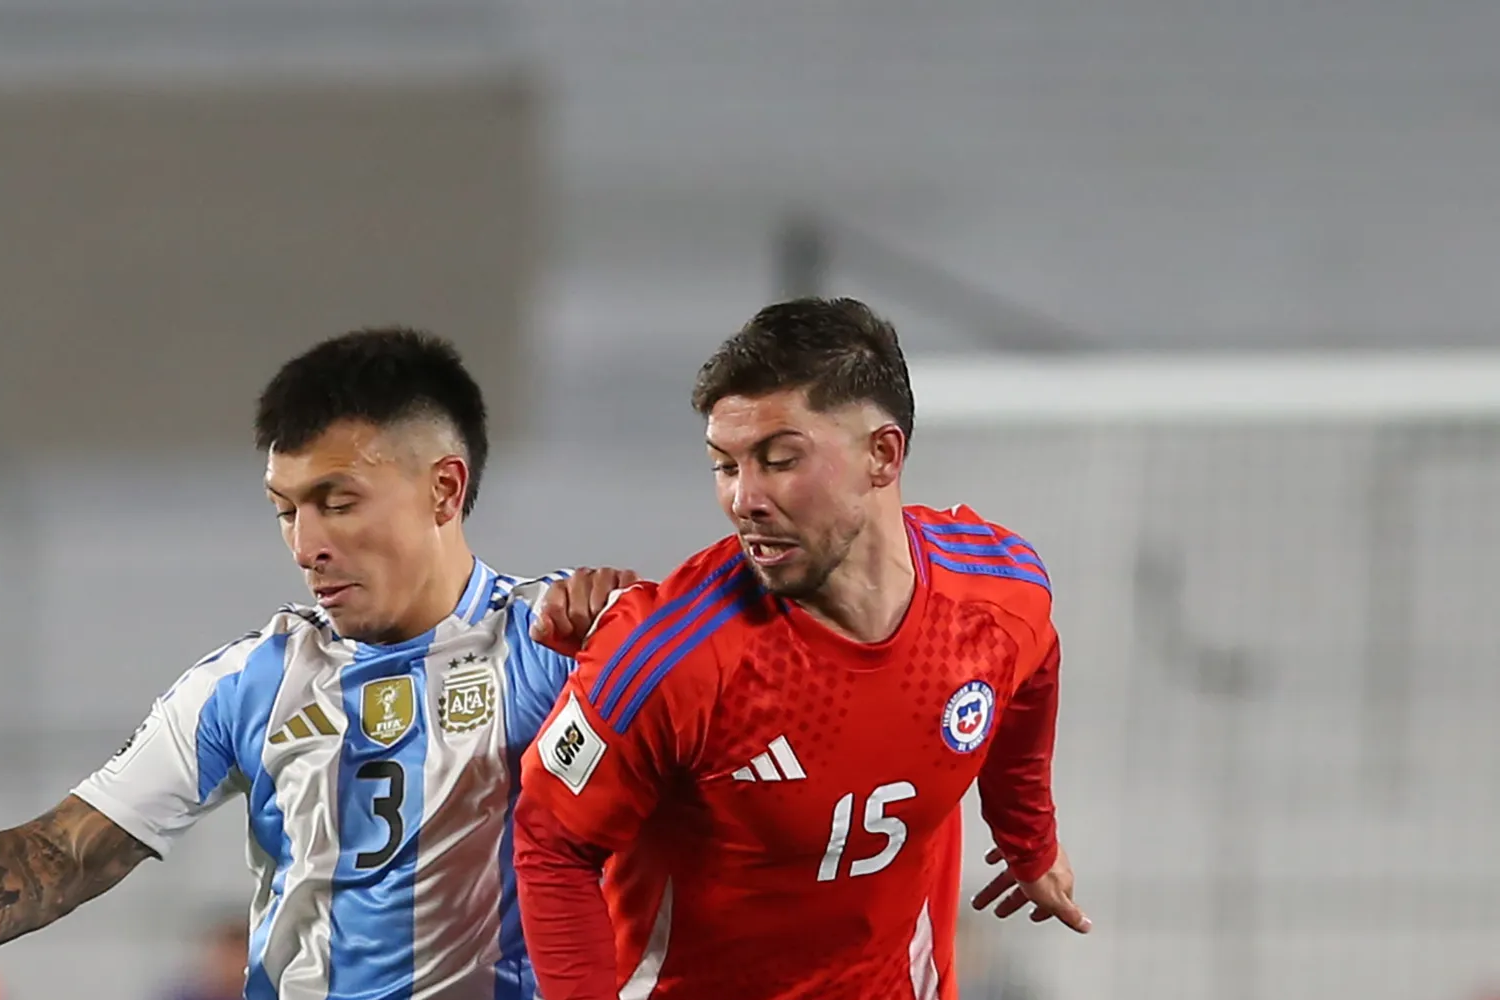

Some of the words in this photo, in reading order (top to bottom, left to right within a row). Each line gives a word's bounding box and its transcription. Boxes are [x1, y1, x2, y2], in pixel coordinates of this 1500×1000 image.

[375, 718, 403, 732] FIFA
[450, 685, 485, 715] AFA
[355, 760, 405, 869] 3
[816, 780, 917, 882] 15
